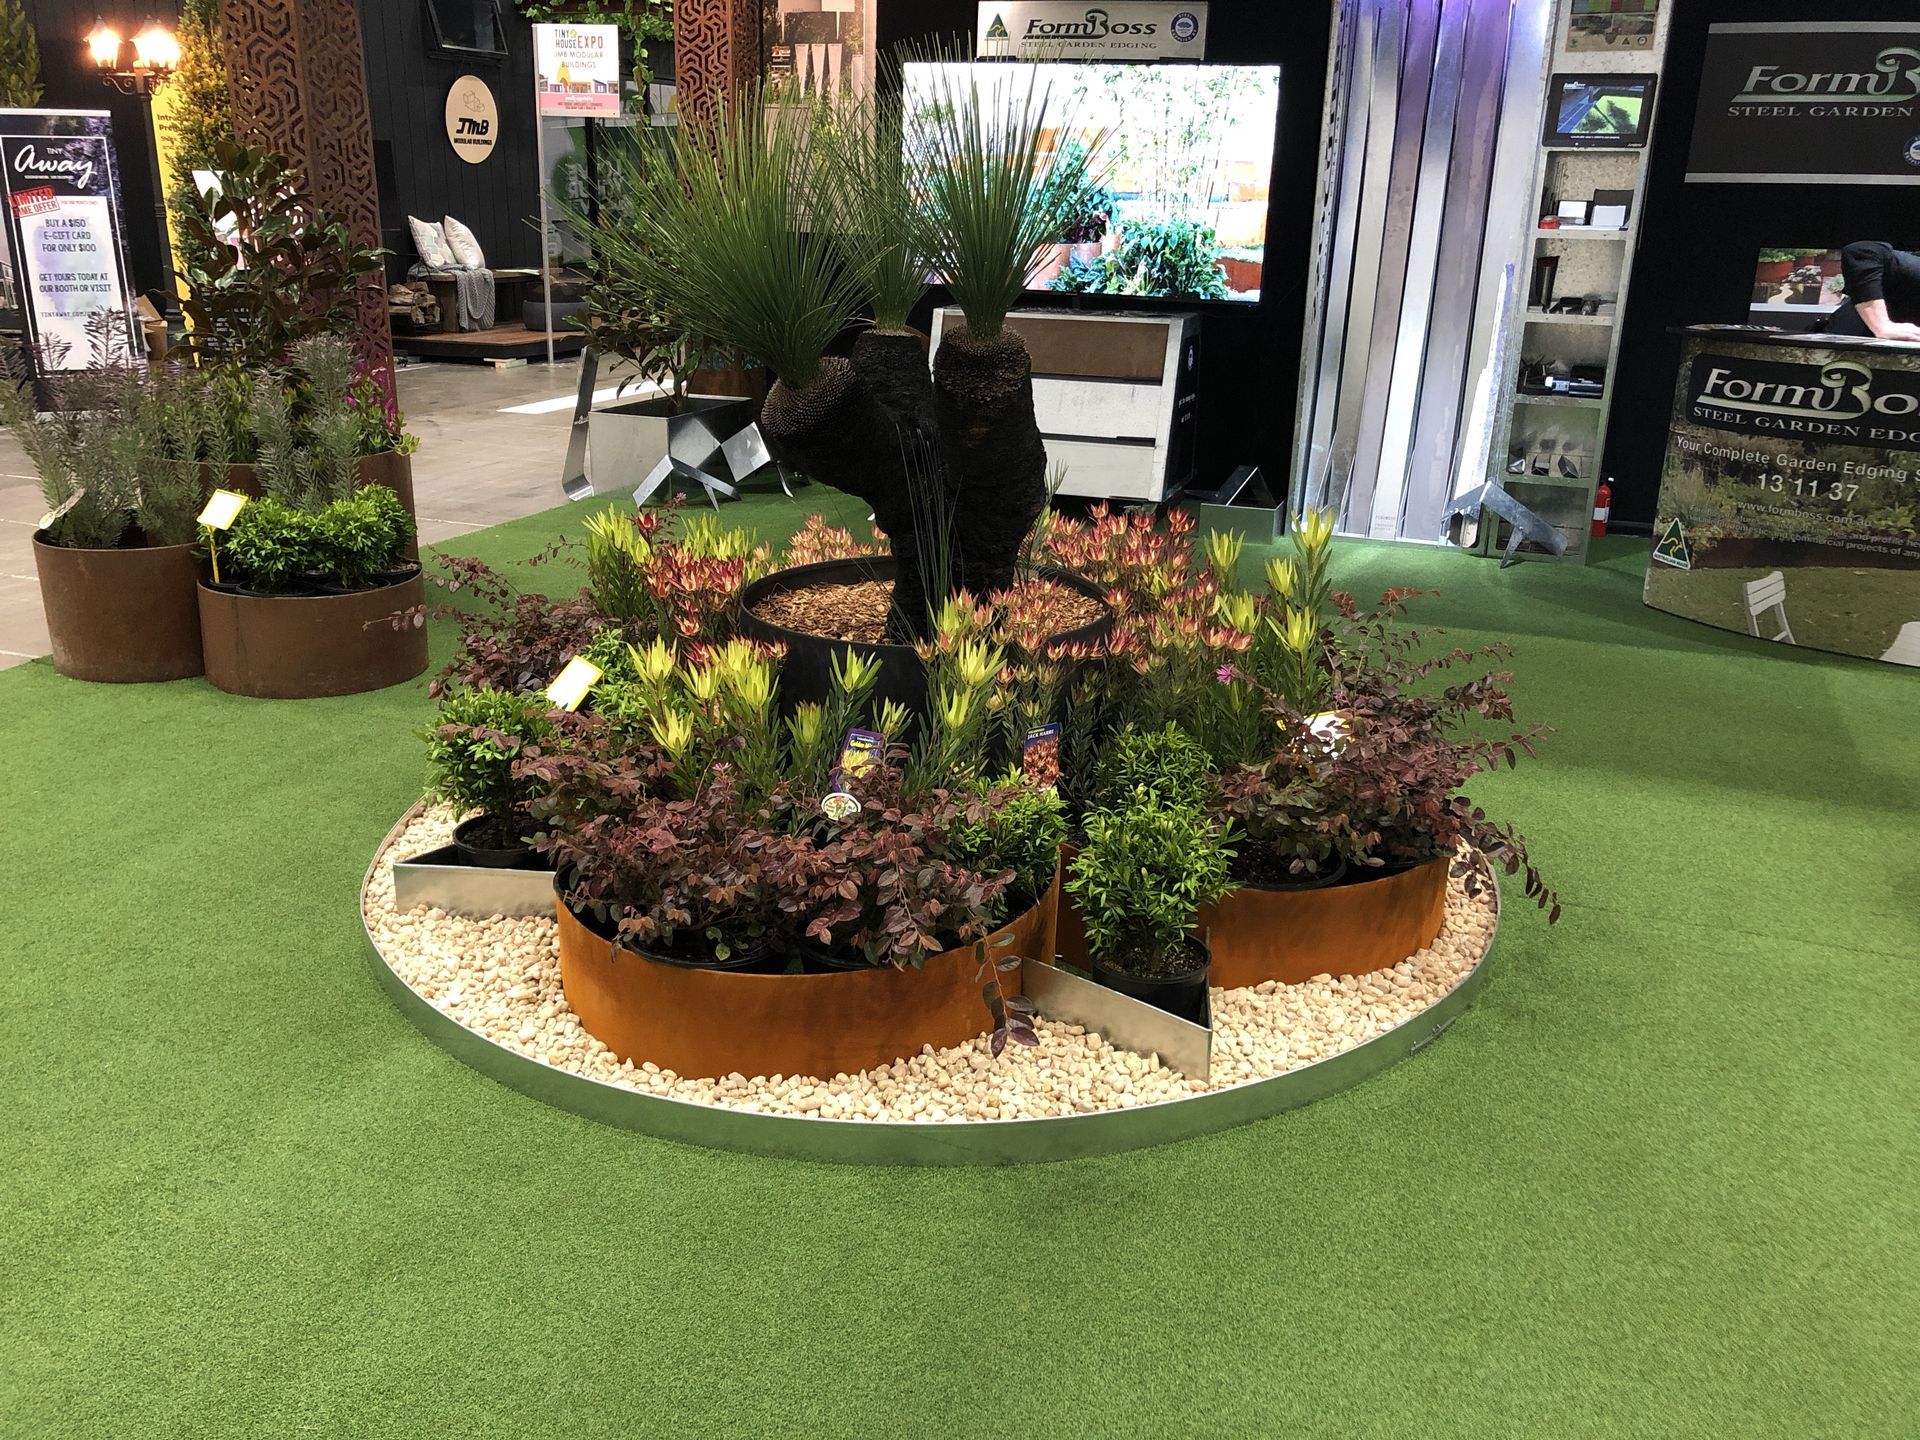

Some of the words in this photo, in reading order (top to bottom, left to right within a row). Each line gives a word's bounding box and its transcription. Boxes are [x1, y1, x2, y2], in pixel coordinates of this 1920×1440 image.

[1023, 8, 1157, 39] FormBoss
[555, 29, 569, 38] TINY
[556, 39, 577, 49] HOUSE
[577, 35, 604, 49] EXPO
[561, 61, 597, 69] BUILDINGS
[1727, 106, 1801, 117] STEEL
[1809, 106, 1913, 117] GARDEN
[33, 200, 58, 213] OFFER
[45, 219, 59, 228] BUY
[61, 219, 69, 228] A
[43, 231, 70, 240] E-GIFT
[71, 231, 92, 240] CARD
[42, 243, 56, 252] FOR
[58, 243, 77, 252] ONLY
[79, 243, 97, 253] $100
[39, 273, 53, 281] GET
[54, 273, 76, 281] YOURS
[77, 273, 98, 281] TODAY
[99, 273, 109, 281] AT
[39, 285, 54, 293] OUR
[55, 284, 79, 293] BOOTH
[79, 284, 89, 292] OR
[90, 284, 112, 292] VISIT
[1696, 361, 1920, 420] FormBo
[1693, 406, 1748, 425] STEEL
[1755, 416, 1860, 437] GARDEN
[1677, 436, 1701, 451] Your
[1704, 442, 1770, 464] Complete
[1776, 454, 1837, 472] Garden
[1843, 461, 1908, 483] Edging
[1758, 473, 1784, 493] 13
[1793, 478, 1818, 498] 11
[1828, 482, 1860, 502] 37
[1737, 500, 1873, 527] www.formboss.com.au
[1846, 541, 1889, 553] projects
[1890, 546, 1902, 556] of
